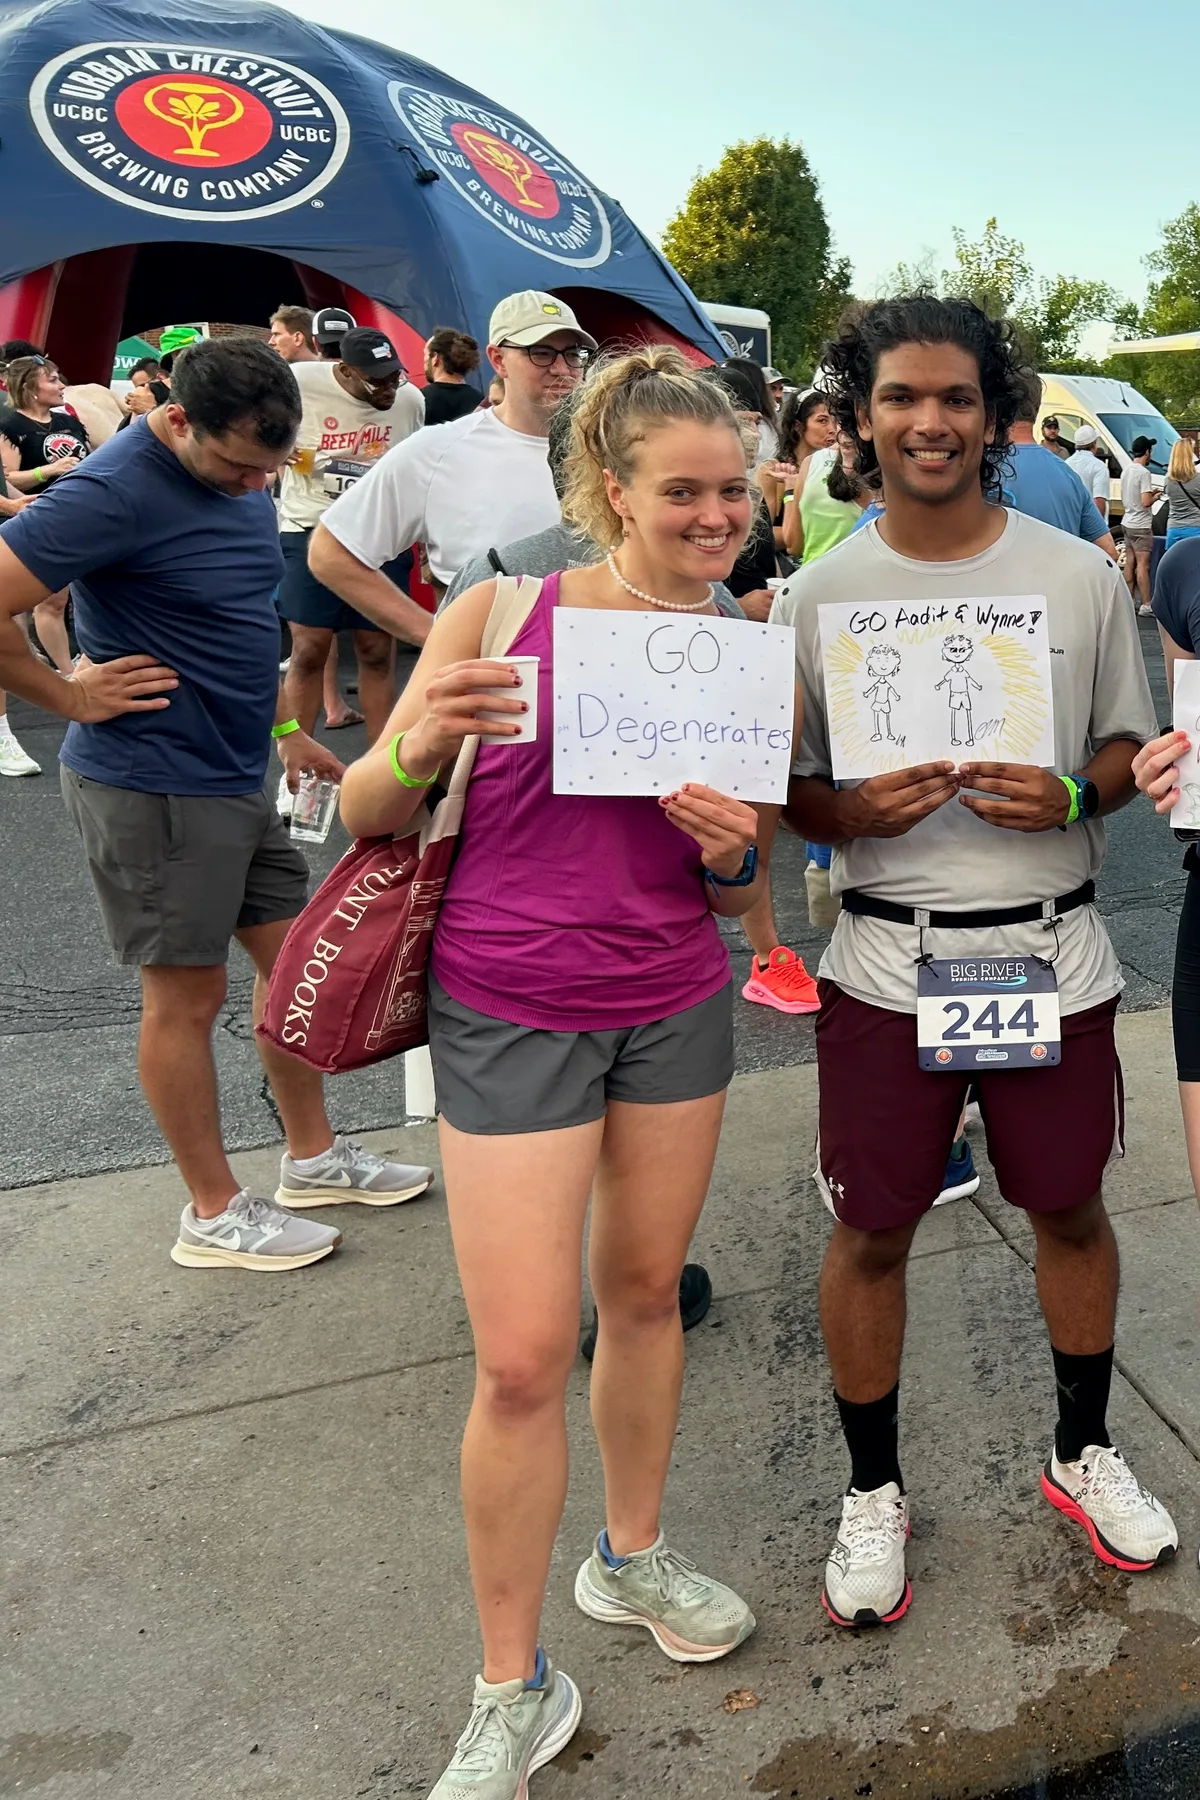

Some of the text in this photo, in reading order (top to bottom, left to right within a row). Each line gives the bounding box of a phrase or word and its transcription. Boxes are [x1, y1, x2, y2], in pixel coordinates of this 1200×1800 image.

[59, 49, 323, 118] URBAN CHESTNUT
[53, 103, 108, 122] UCBC
[280, 125, 331, 143] UCBC
[407, 93, 566, 174] URBAN CHESTNUT
[77, 131, 310, 200] BREWING COMPANY
[466, 179, 592, 249] BREWING COMPANY
[321, 426, 392, 455] BEER MILE
[849, 611, 887, 633] GO
[895, 605, 949, 629] Aadit
[954, 604, 969, 626] &
[646, 624, 720, 674] GO
[578, 693, 791, 760] Degenerates
[282, 862, 404, 1047] UNT BOOKS
[950, 962, 1026, 978] BIG RIVER
[942, 999, 1039, 1041] 244
